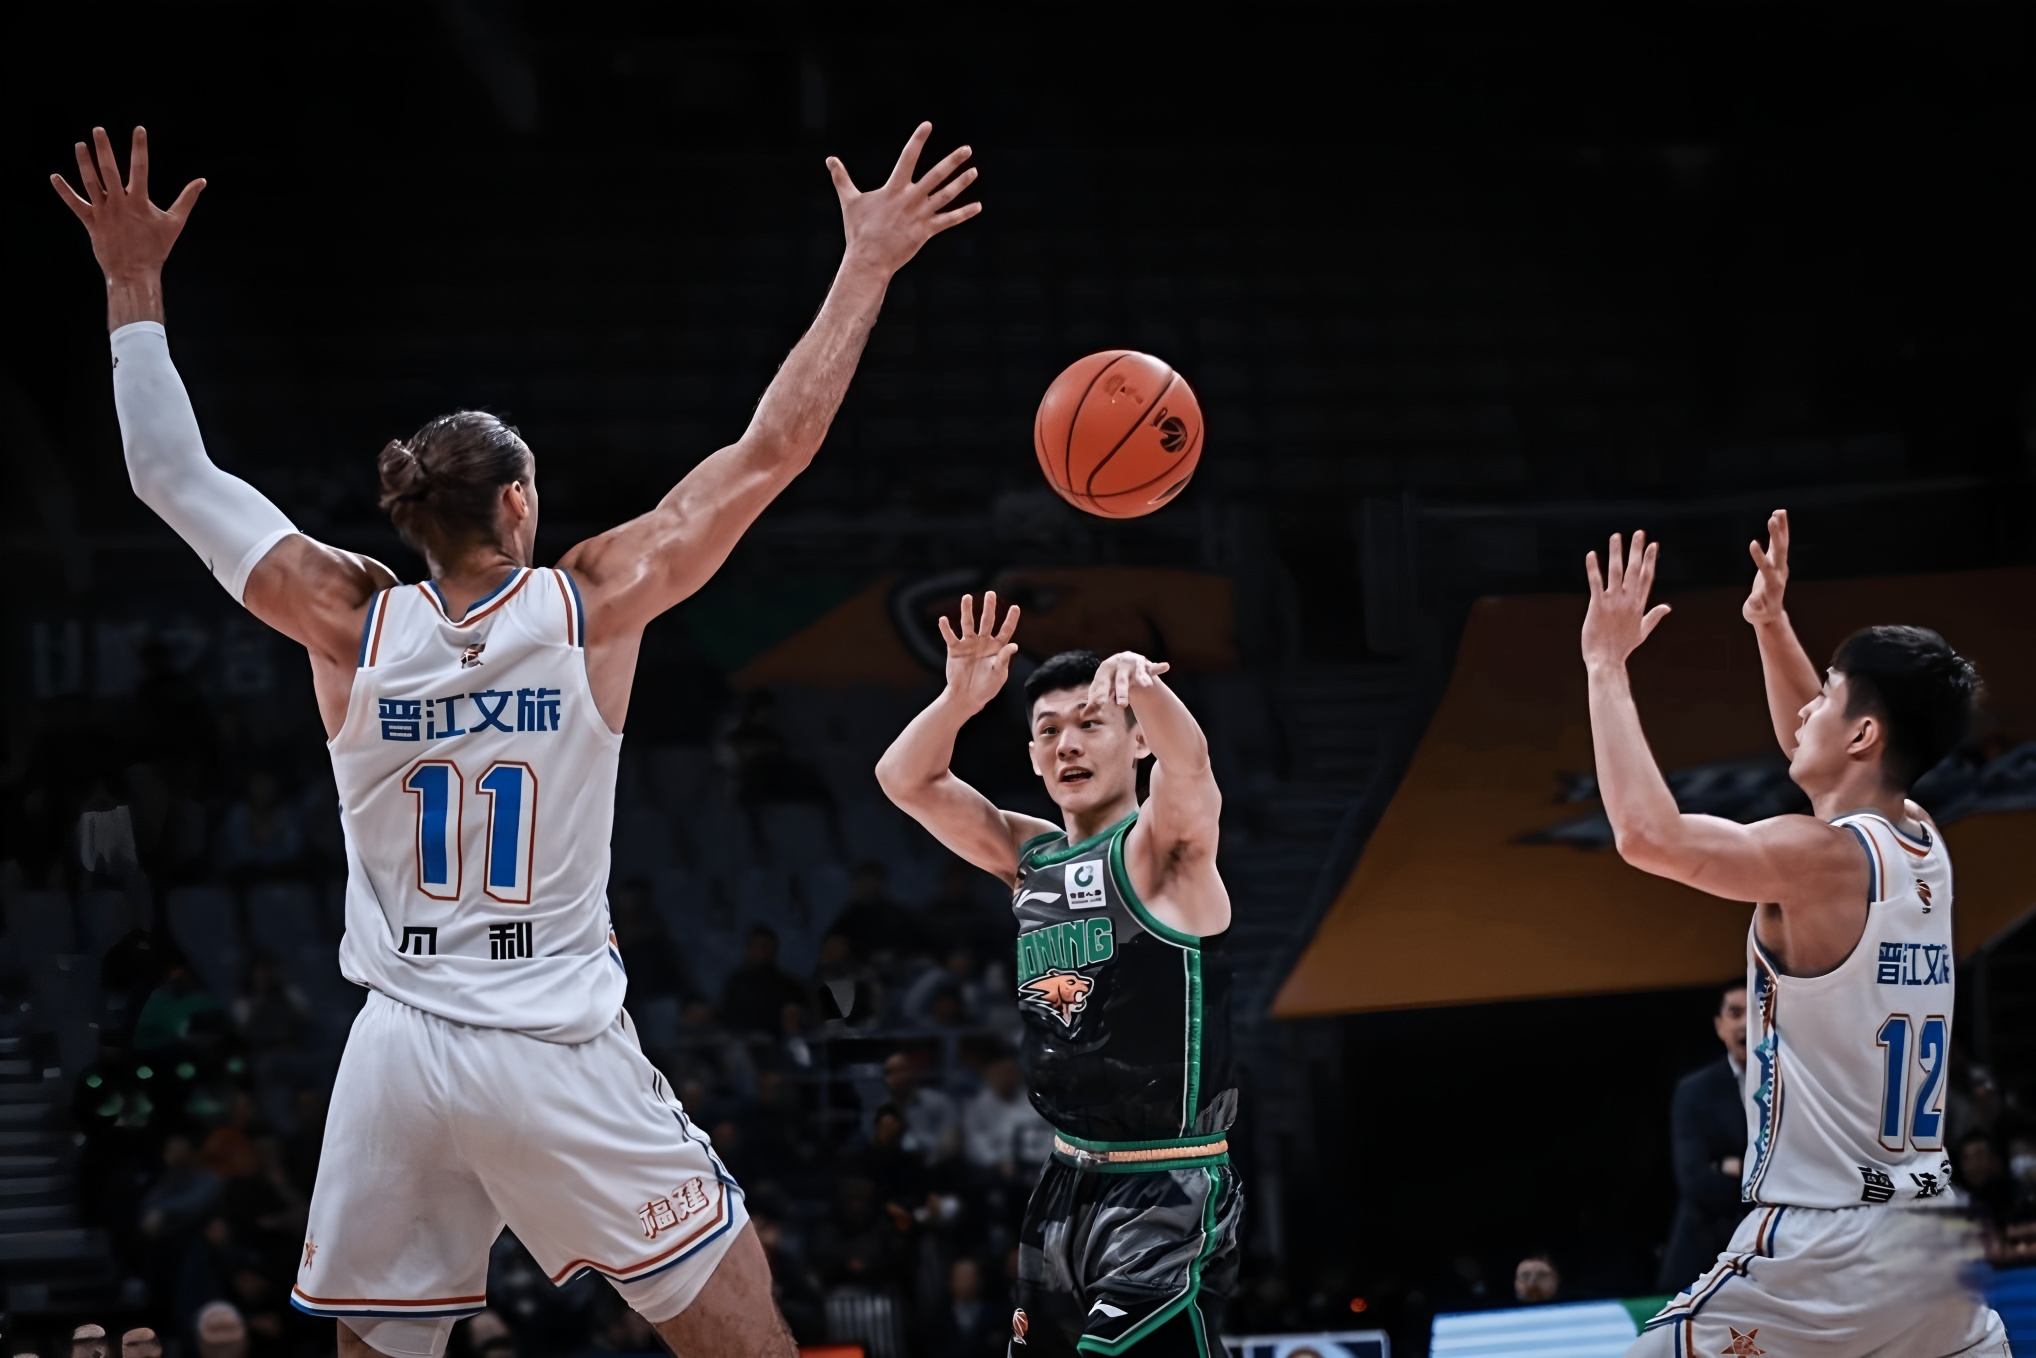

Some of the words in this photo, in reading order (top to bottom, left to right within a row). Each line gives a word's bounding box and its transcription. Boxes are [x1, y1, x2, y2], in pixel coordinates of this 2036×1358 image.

[378, 687, 562, 742] 晋江文旅
[402, 759, 538, 905] 11
[1017, 917, 1114, 984] ONING
[1876, 1012, 1948, 1153] 12
[638, 1176, 710, 1240] 福建
